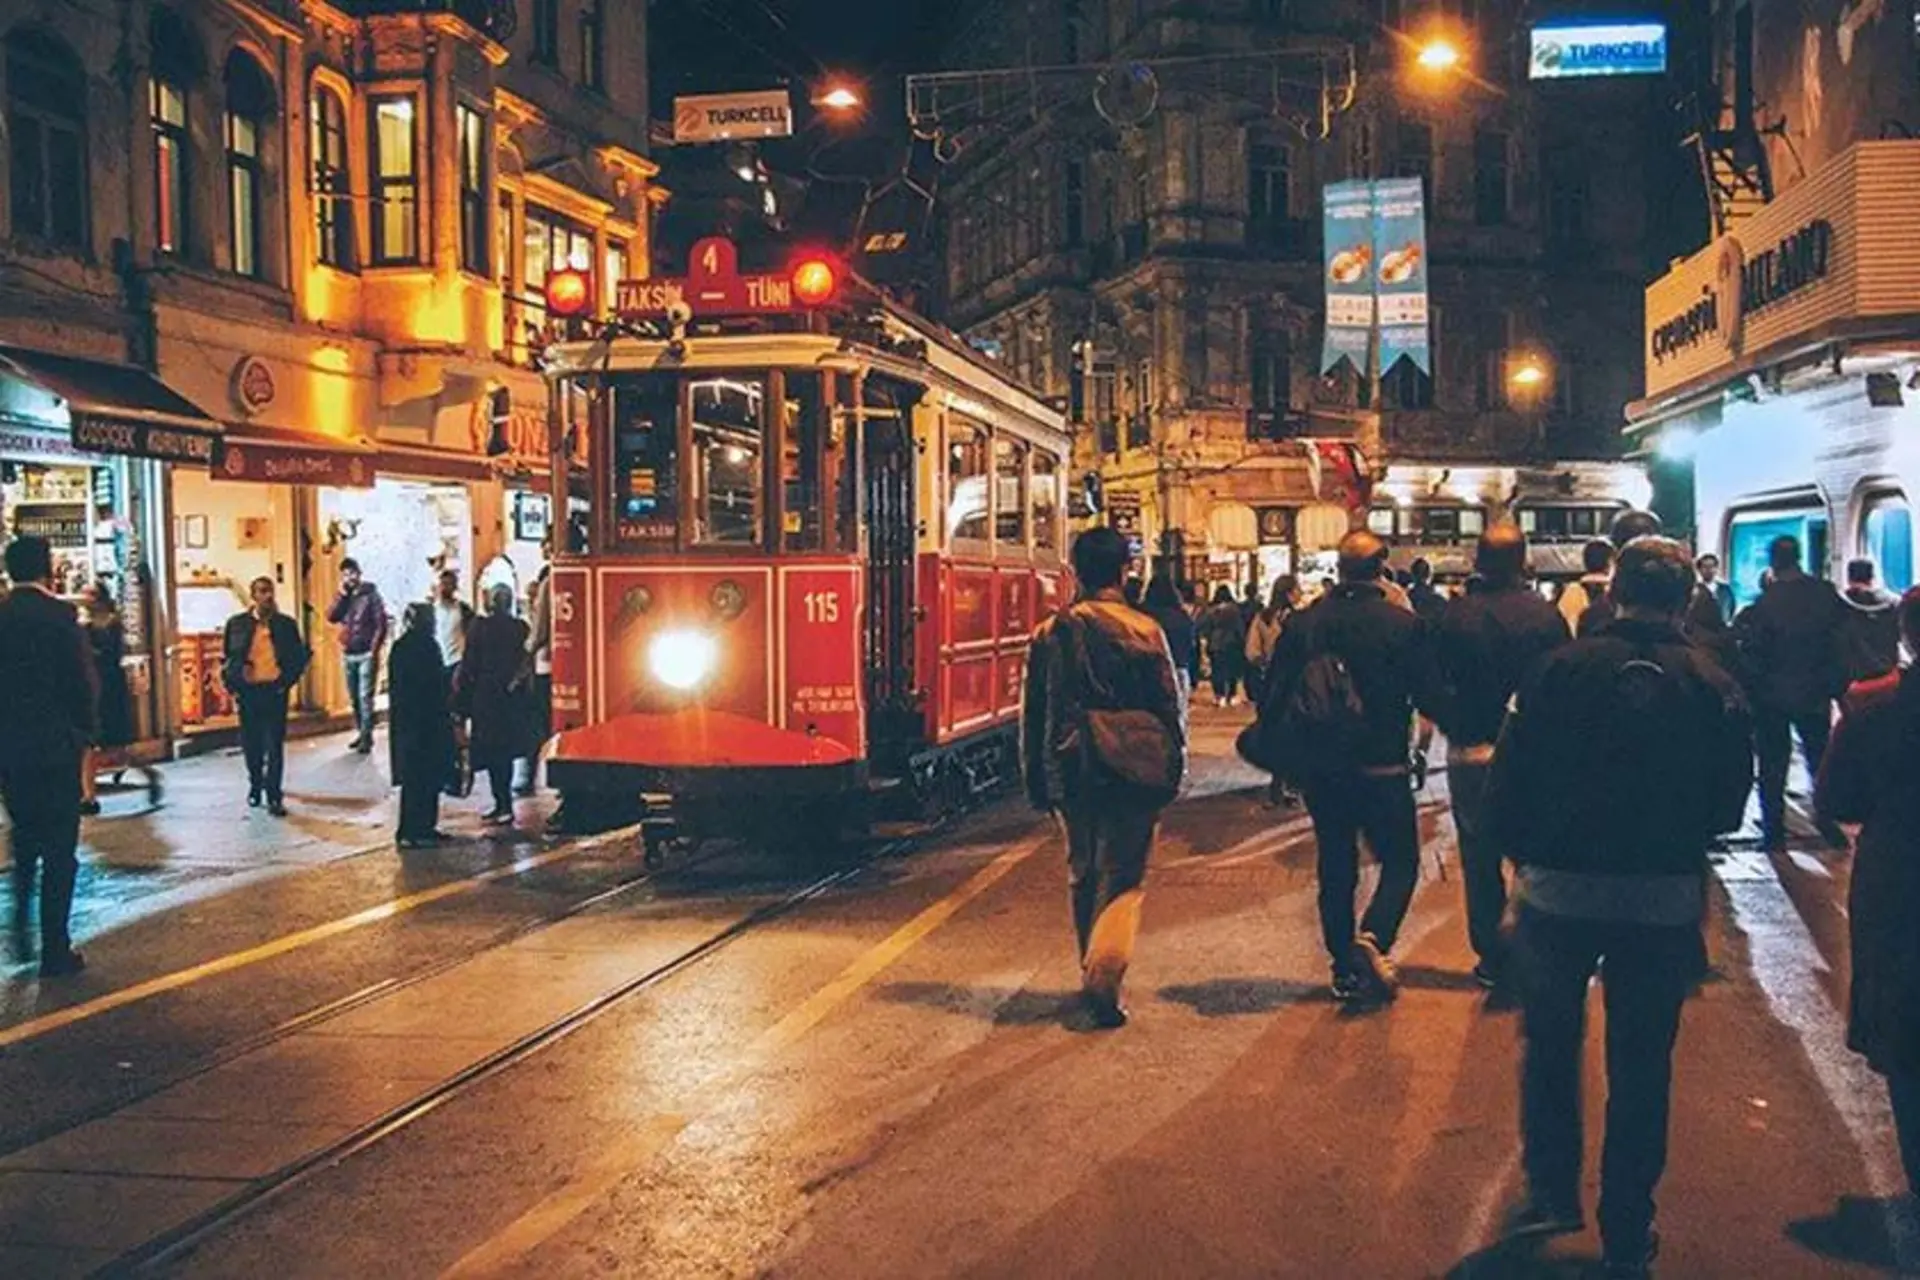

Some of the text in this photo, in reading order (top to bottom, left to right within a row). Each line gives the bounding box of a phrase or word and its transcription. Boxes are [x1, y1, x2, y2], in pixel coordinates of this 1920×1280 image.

[1569, 41, 1660, 61] TURKCELL
[707, 106, 787, 125] TURKCELL
[804, 592, 838, 622] 115
